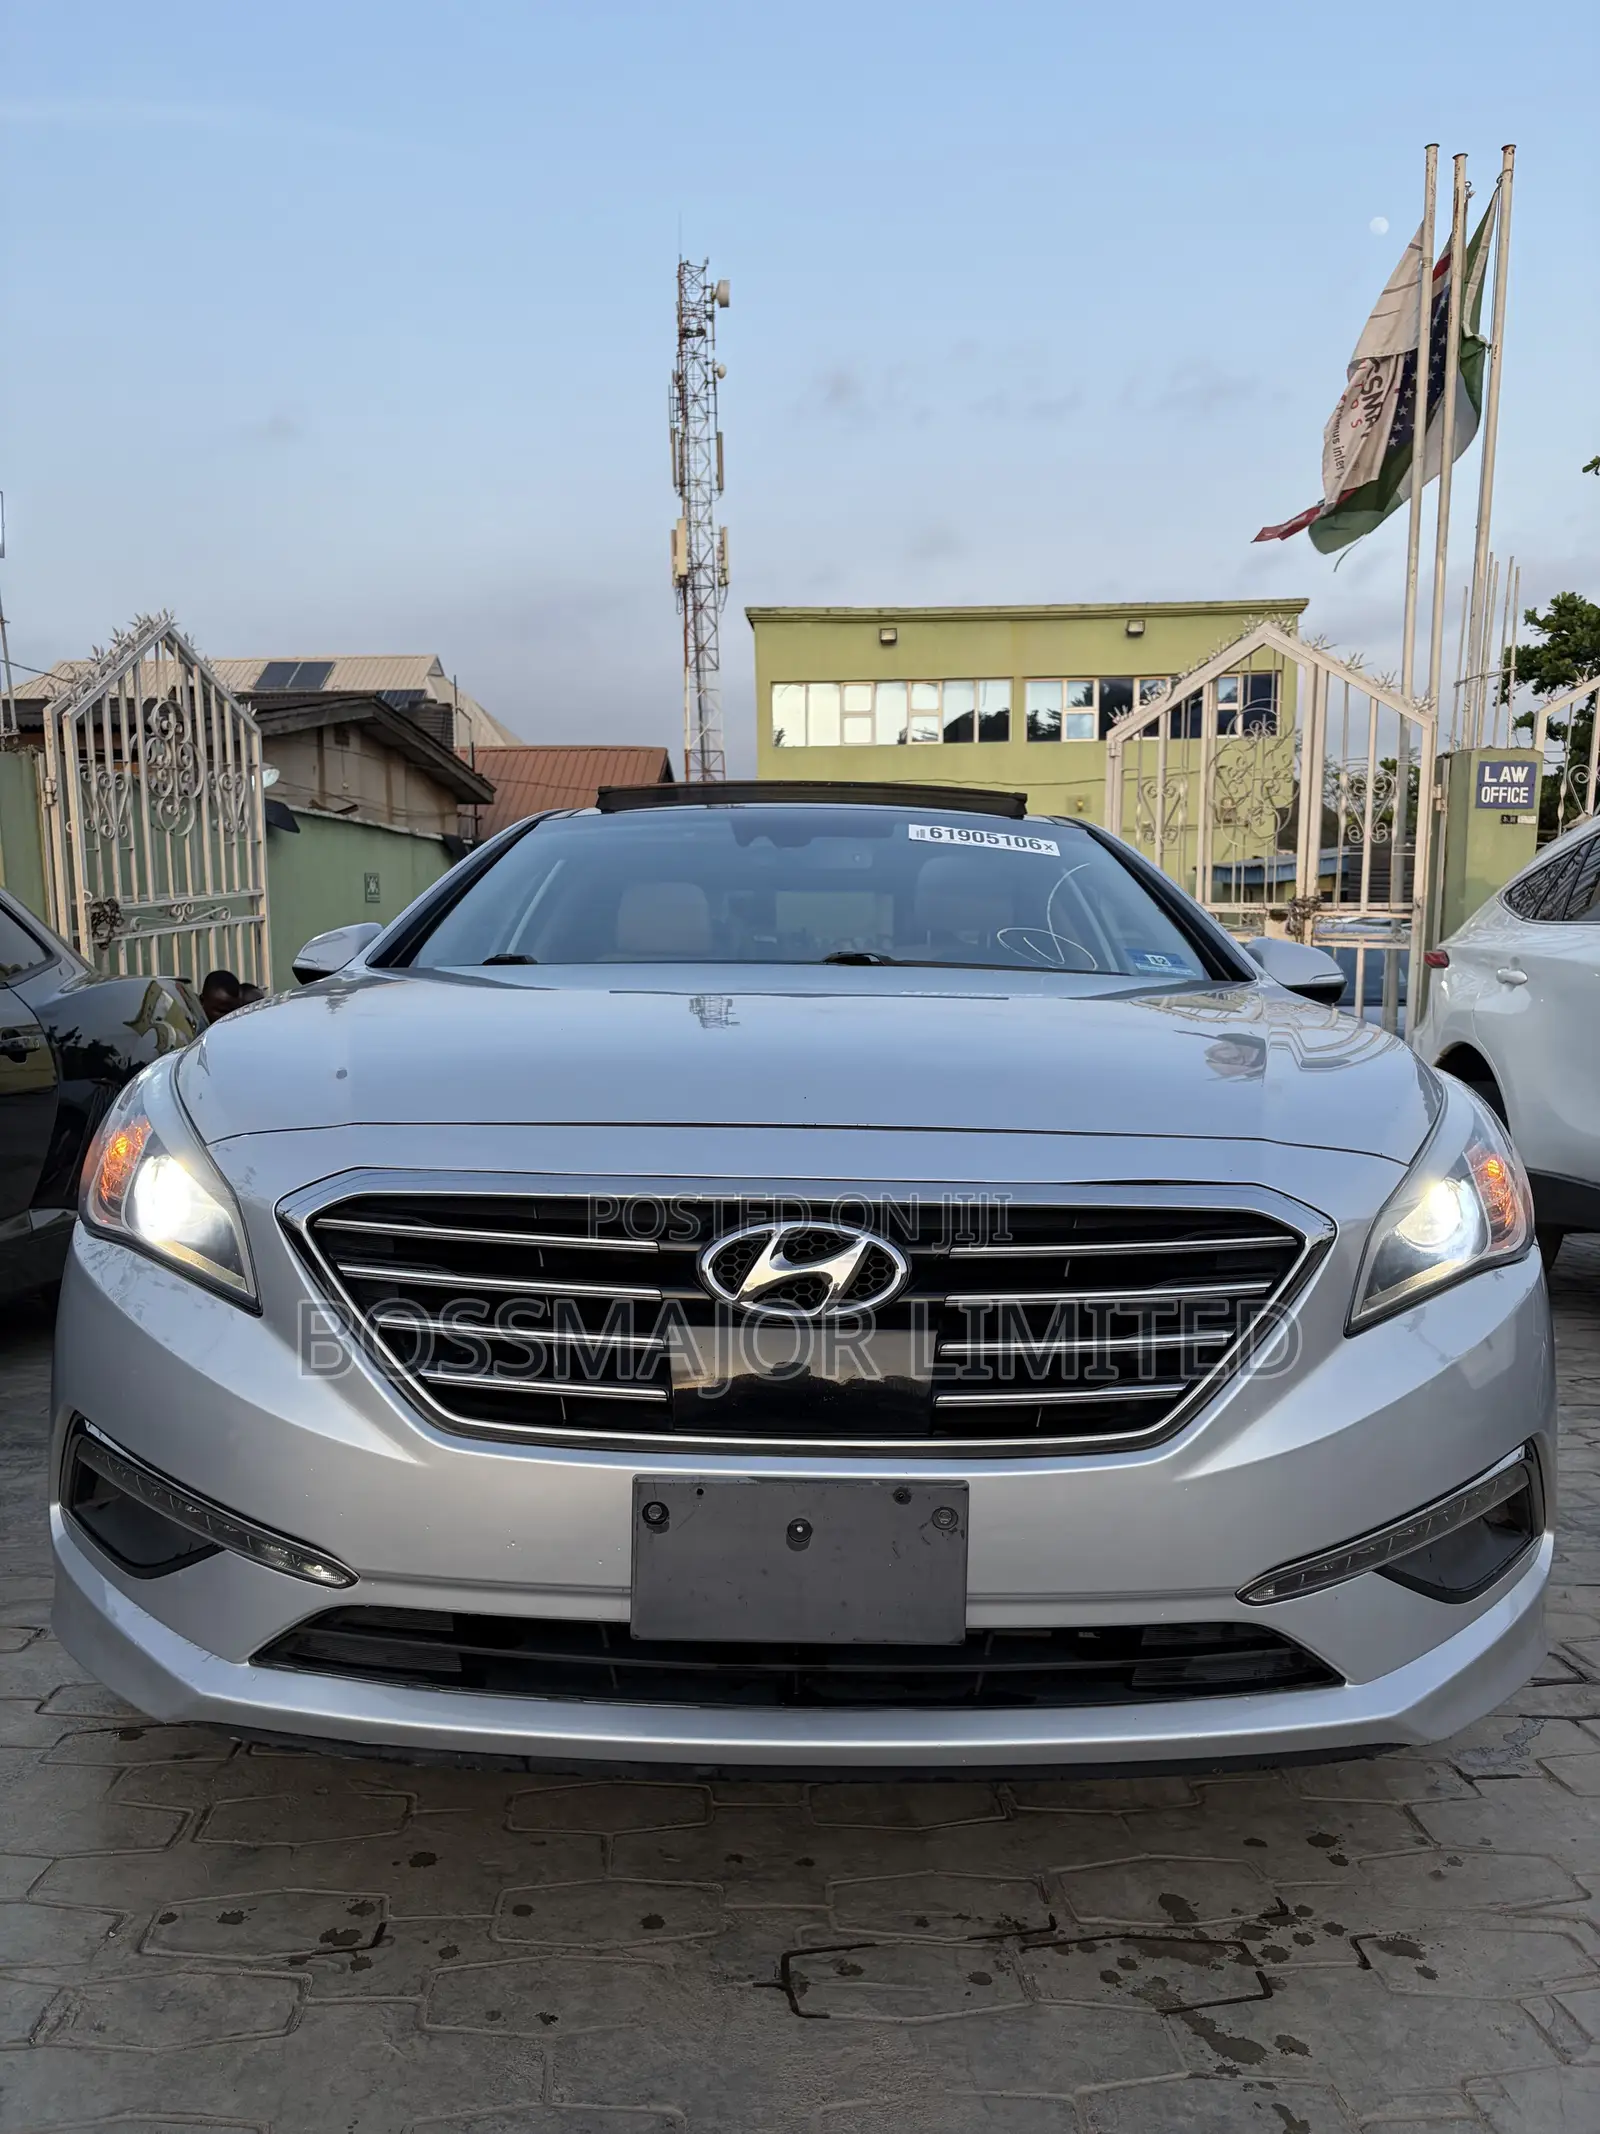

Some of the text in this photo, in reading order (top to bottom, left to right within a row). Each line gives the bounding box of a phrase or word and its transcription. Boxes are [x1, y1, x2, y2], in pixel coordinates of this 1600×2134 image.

[1333, 446, 1345, 471] inter
[1484, 765, 1529, 783] LAW
[1481, 786, 1529, 804] OFFICE
